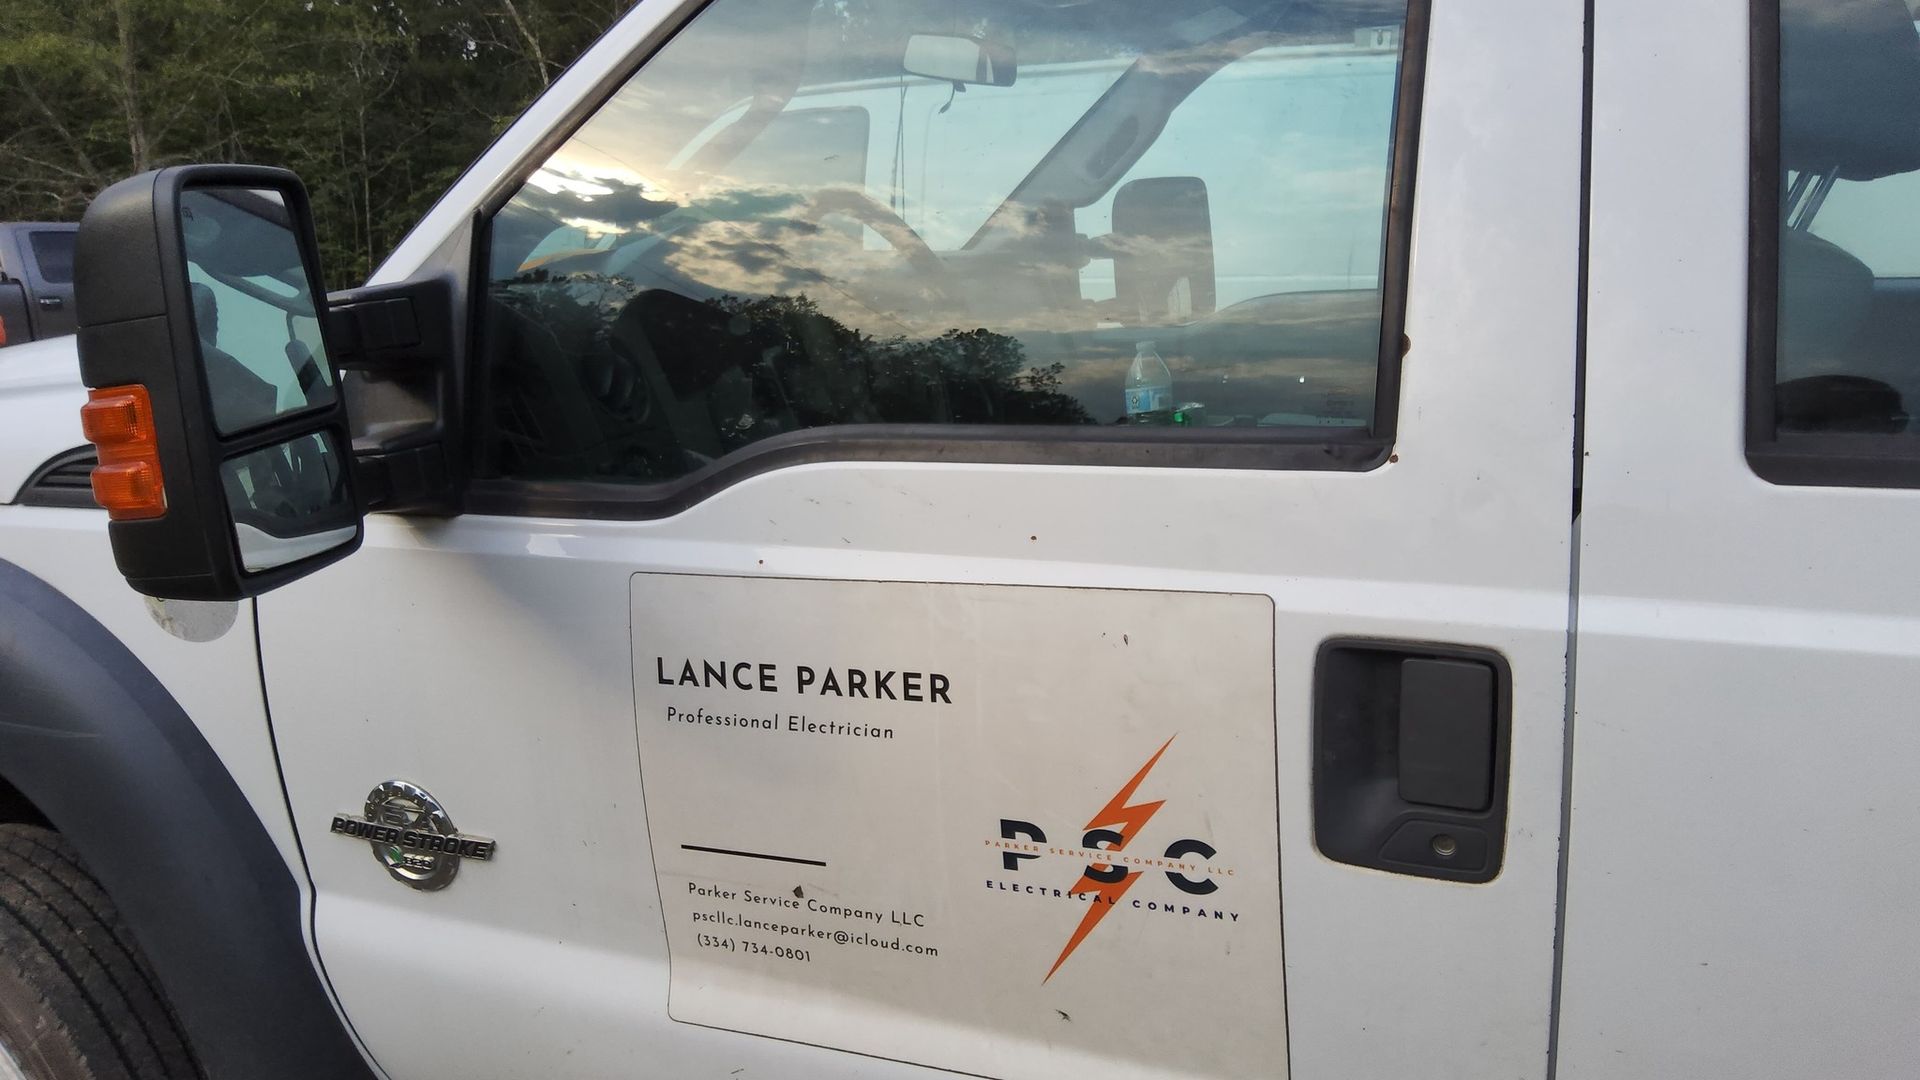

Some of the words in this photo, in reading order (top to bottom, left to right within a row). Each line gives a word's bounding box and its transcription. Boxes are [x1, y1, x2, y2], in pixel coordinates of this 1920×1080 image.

[657, 657, 778, 692] LANCE
[797, 666, 952, 704] PARKER
[667, 706, 778, 730] Professional
[788, 715, 894, 739] Electrician
[330, 815, 401, 844] POWER
[402, 830, 496, 861] STROKE
[985, 840, 1040, 852] PARKER
[1050, 848, 1112, 861] SERVICE
[1123, 857, 1197, 871] COMPANY
[1207, 866, 1235, 876] LLC
[688, 882, 737, 900] Parker
[744, 890, 800, 909] Service
[807, 899, 883, 924] Company
[891, 910, 925, 927] LLC
[986, 880, 1115, 905] ELECTRICAL
[1132, 899, 1239, 922] COMPANY
[693, 910, 939, 957] pscllc.lanceparker@icloud.com
[697, 933, 736, 952] (334)
[742, 941, 811, 962] 734-0801
